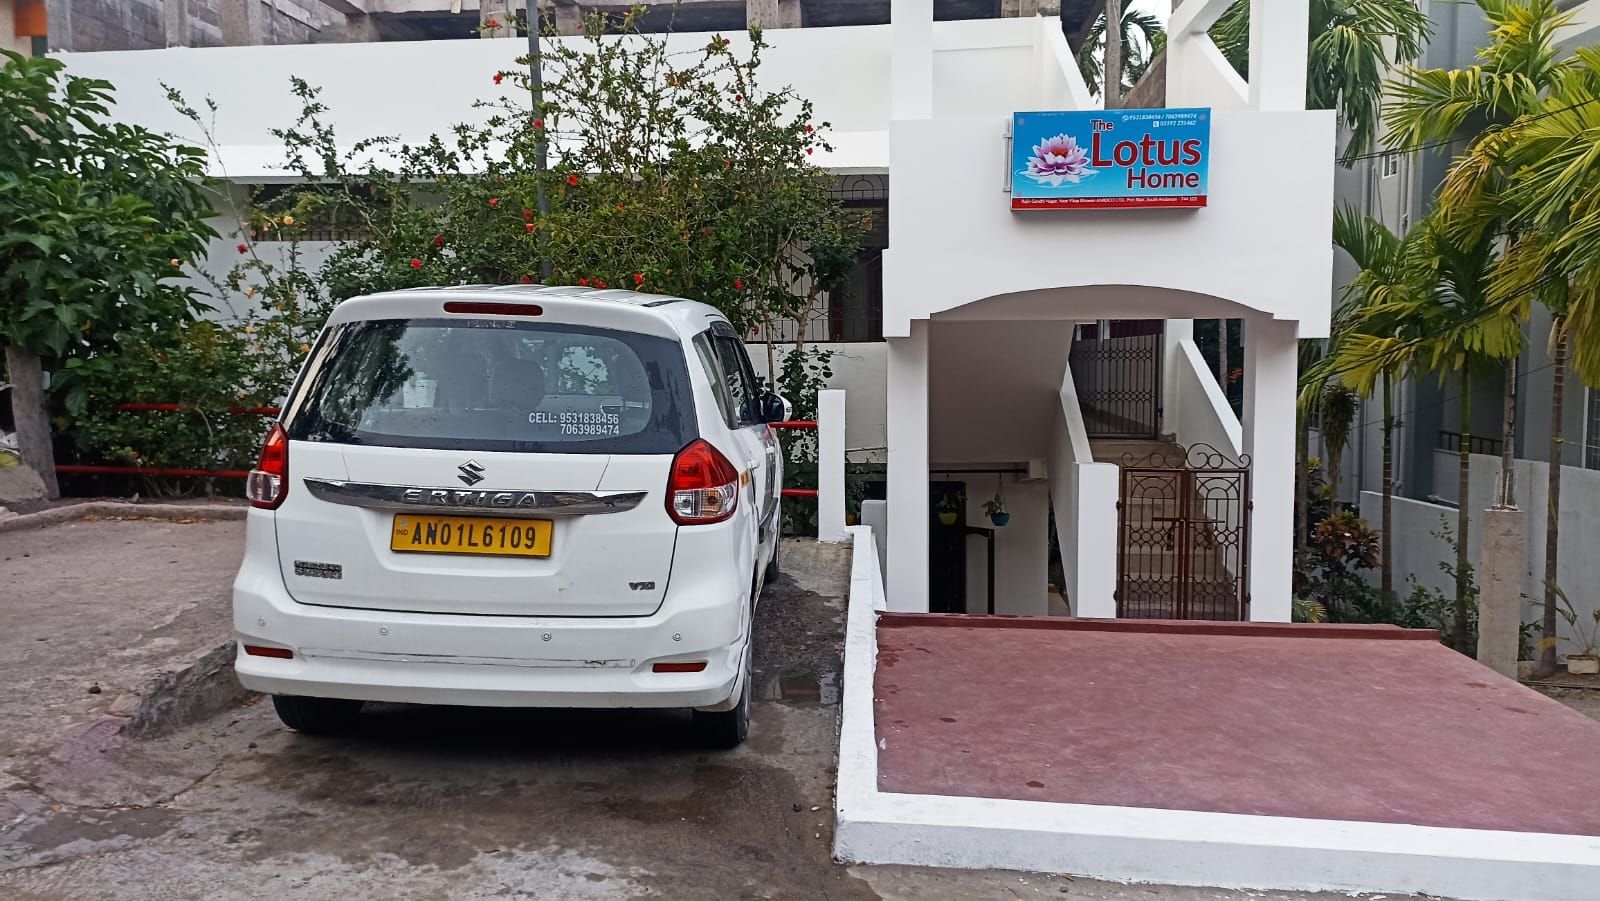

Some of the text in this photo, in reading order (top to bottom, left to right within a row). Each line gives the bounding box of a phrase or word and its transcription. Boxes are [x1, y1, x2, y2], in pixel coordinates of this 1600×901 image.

[1090, 119, 1114, 132] The
[1092, 132, 1201, 167] Lotus
[1127, 167, 1200, 189] Home
[528, 412, 620, 424] CELL: 9531838456
[559, 423, 620, 435] 7063989474
[402, 488, 538, 509] ERTIGA
[411, 521, 537, 549] AN01L6109
